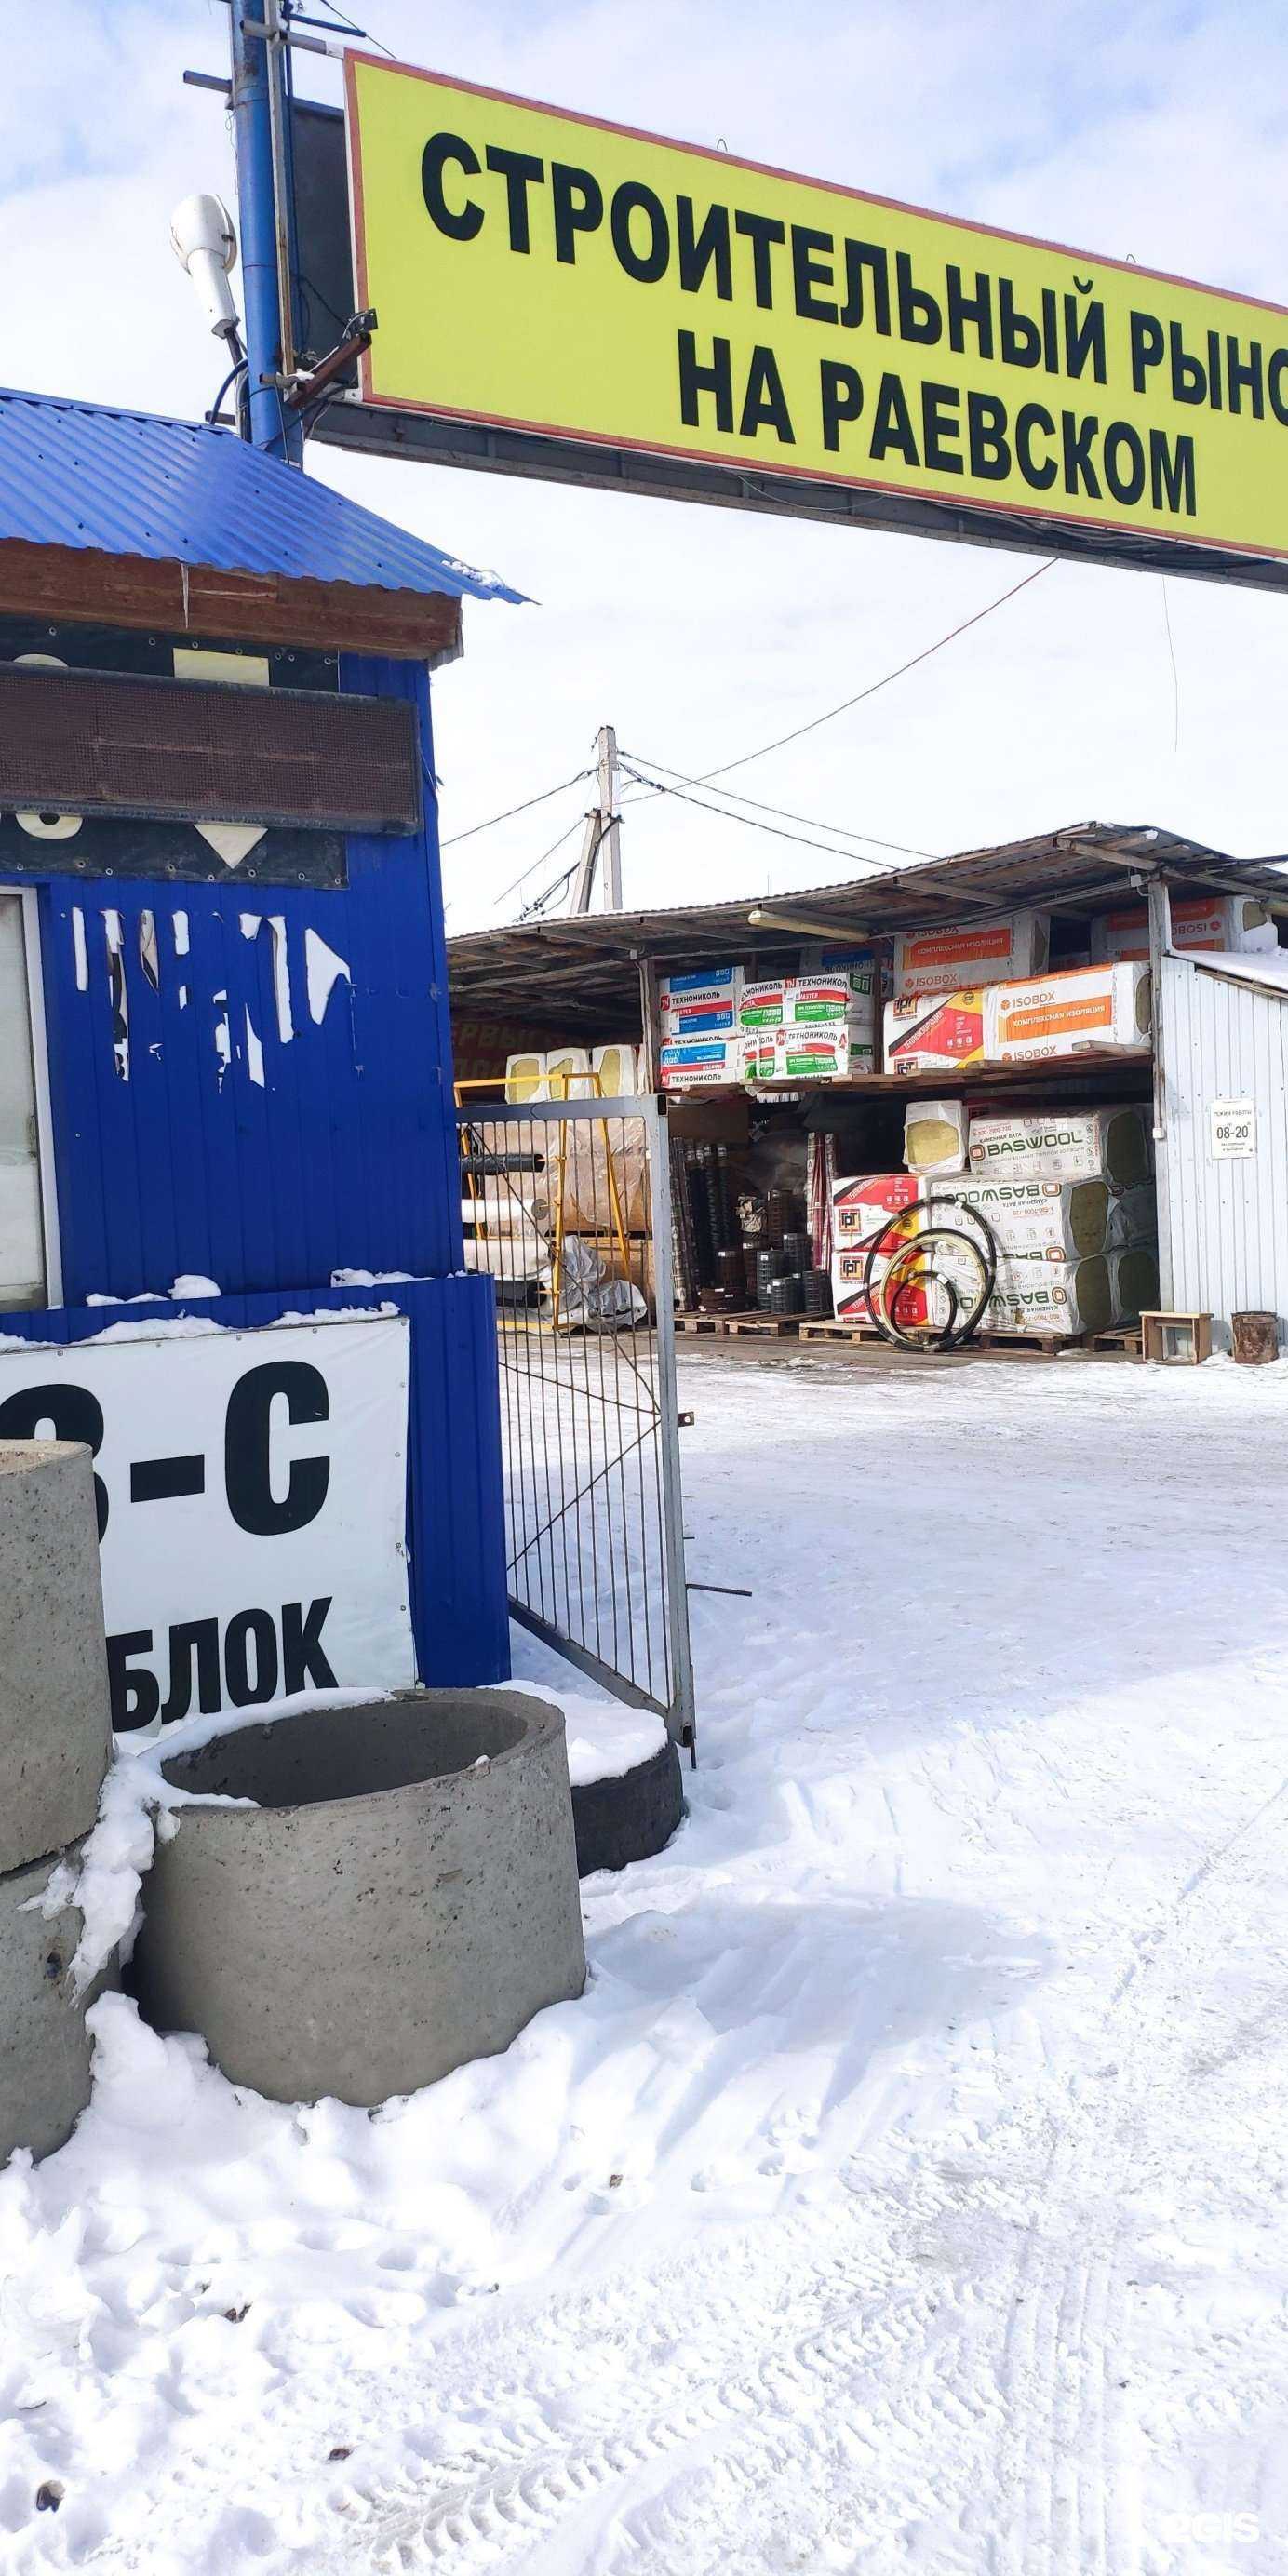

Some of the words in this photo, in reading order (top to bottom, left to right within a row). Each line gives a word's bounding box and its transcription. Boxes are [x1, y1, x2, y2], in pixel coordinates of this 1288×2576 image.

[421, 132, 1107, 385] СТРОИТЕЛЬНЫЙ
[678, 330, 796, 445] НА
[821, 359, 1198, 517] РАЕВСКОМ
[798, 977, 848, 987] ТЕХНОНИКОЛ
[916, 974, 958, 986] ISOBOX
[672, 992, 720, 1005] ТЕХНОНИКОЛЬ
[1013, 991, 1056, 1008] ISOBOX
[1013, 1012, 1065, 1026] КОМПЛЕКСНАЯ
[1066, 1004, 1106, 1018] ИЗОЛЯЦИЯ
[1014, 1046, 1057, 1061] ISOBOX
[672, 1074, 721, 1083] ТЕХНОНИКОЛЬ
[1216, 1125, 1249, 1139] 08-20
[987, 1132, 1083, 1156] BASWOOL
